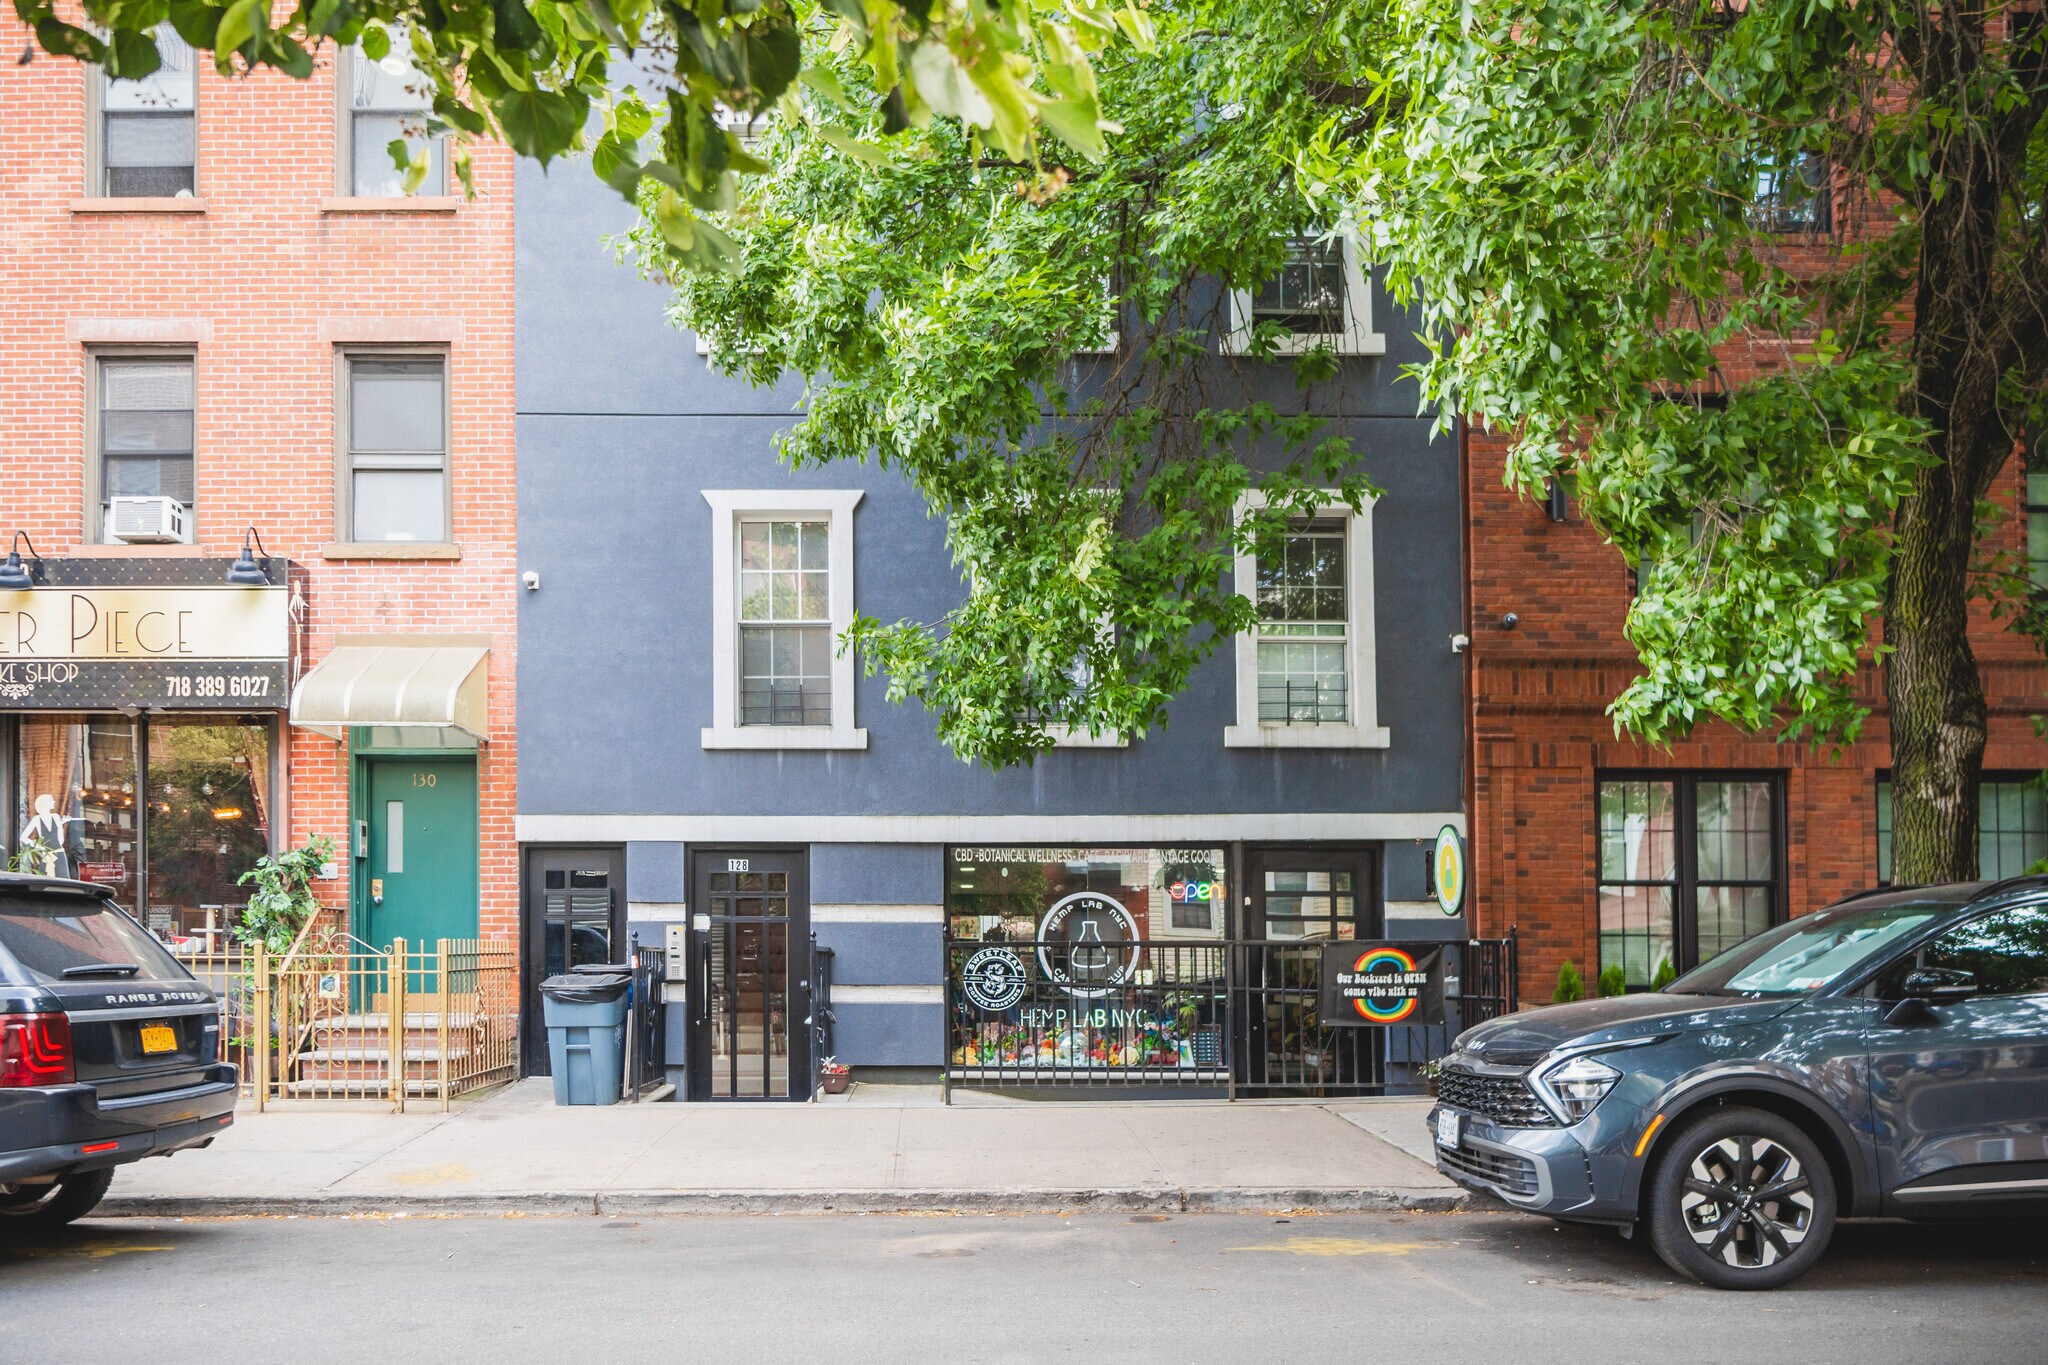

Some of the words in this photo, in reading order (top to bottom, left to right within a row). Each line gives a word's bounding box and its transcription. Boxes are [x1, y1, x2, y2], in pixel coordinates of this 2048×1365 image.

[71, 594, 193, 653] PIECE
[25, 663, 78, 683] SHOP
[166, 676, 191, 697] 718
[195, 676, 225, 697] 389
[230, 676, 270, 697] 6027
[412, 773, 437, 787] 130
[730, 860, 747, 870] 128
[955, 848, 973, 862] CBD
[1048, 904, 1074, 931] HEMP
[1081, 900, 1103, 909] LAB
[968, 950, 1022, 970] SWEETLEAF
[1336, 972, 1353, 984] Our
[1354, 972, 1393, 984] Backyard
[1393, 973, 1403, 984] is
[1404, 973, 1427, 984] OPEN
[105, 993, 158, 1004] RANGE
[161, 992, 199, 1001] ROVER
[968, 986, 989, 1007] COFFEE
[990, 988, 1021, 1008] ROASTERS
[1343, 988, 1366, 997] come
[1367, 986, 1386, 997] vibe
[1387, 986, 1407, 997] with
[1408, 987, 1418, 997] us
[1020, 1008, 1067, 1028] HEMP
[1072, 1008, 1105, 1028] LAB
[1111, 1008, 1148, 1028] NYC
